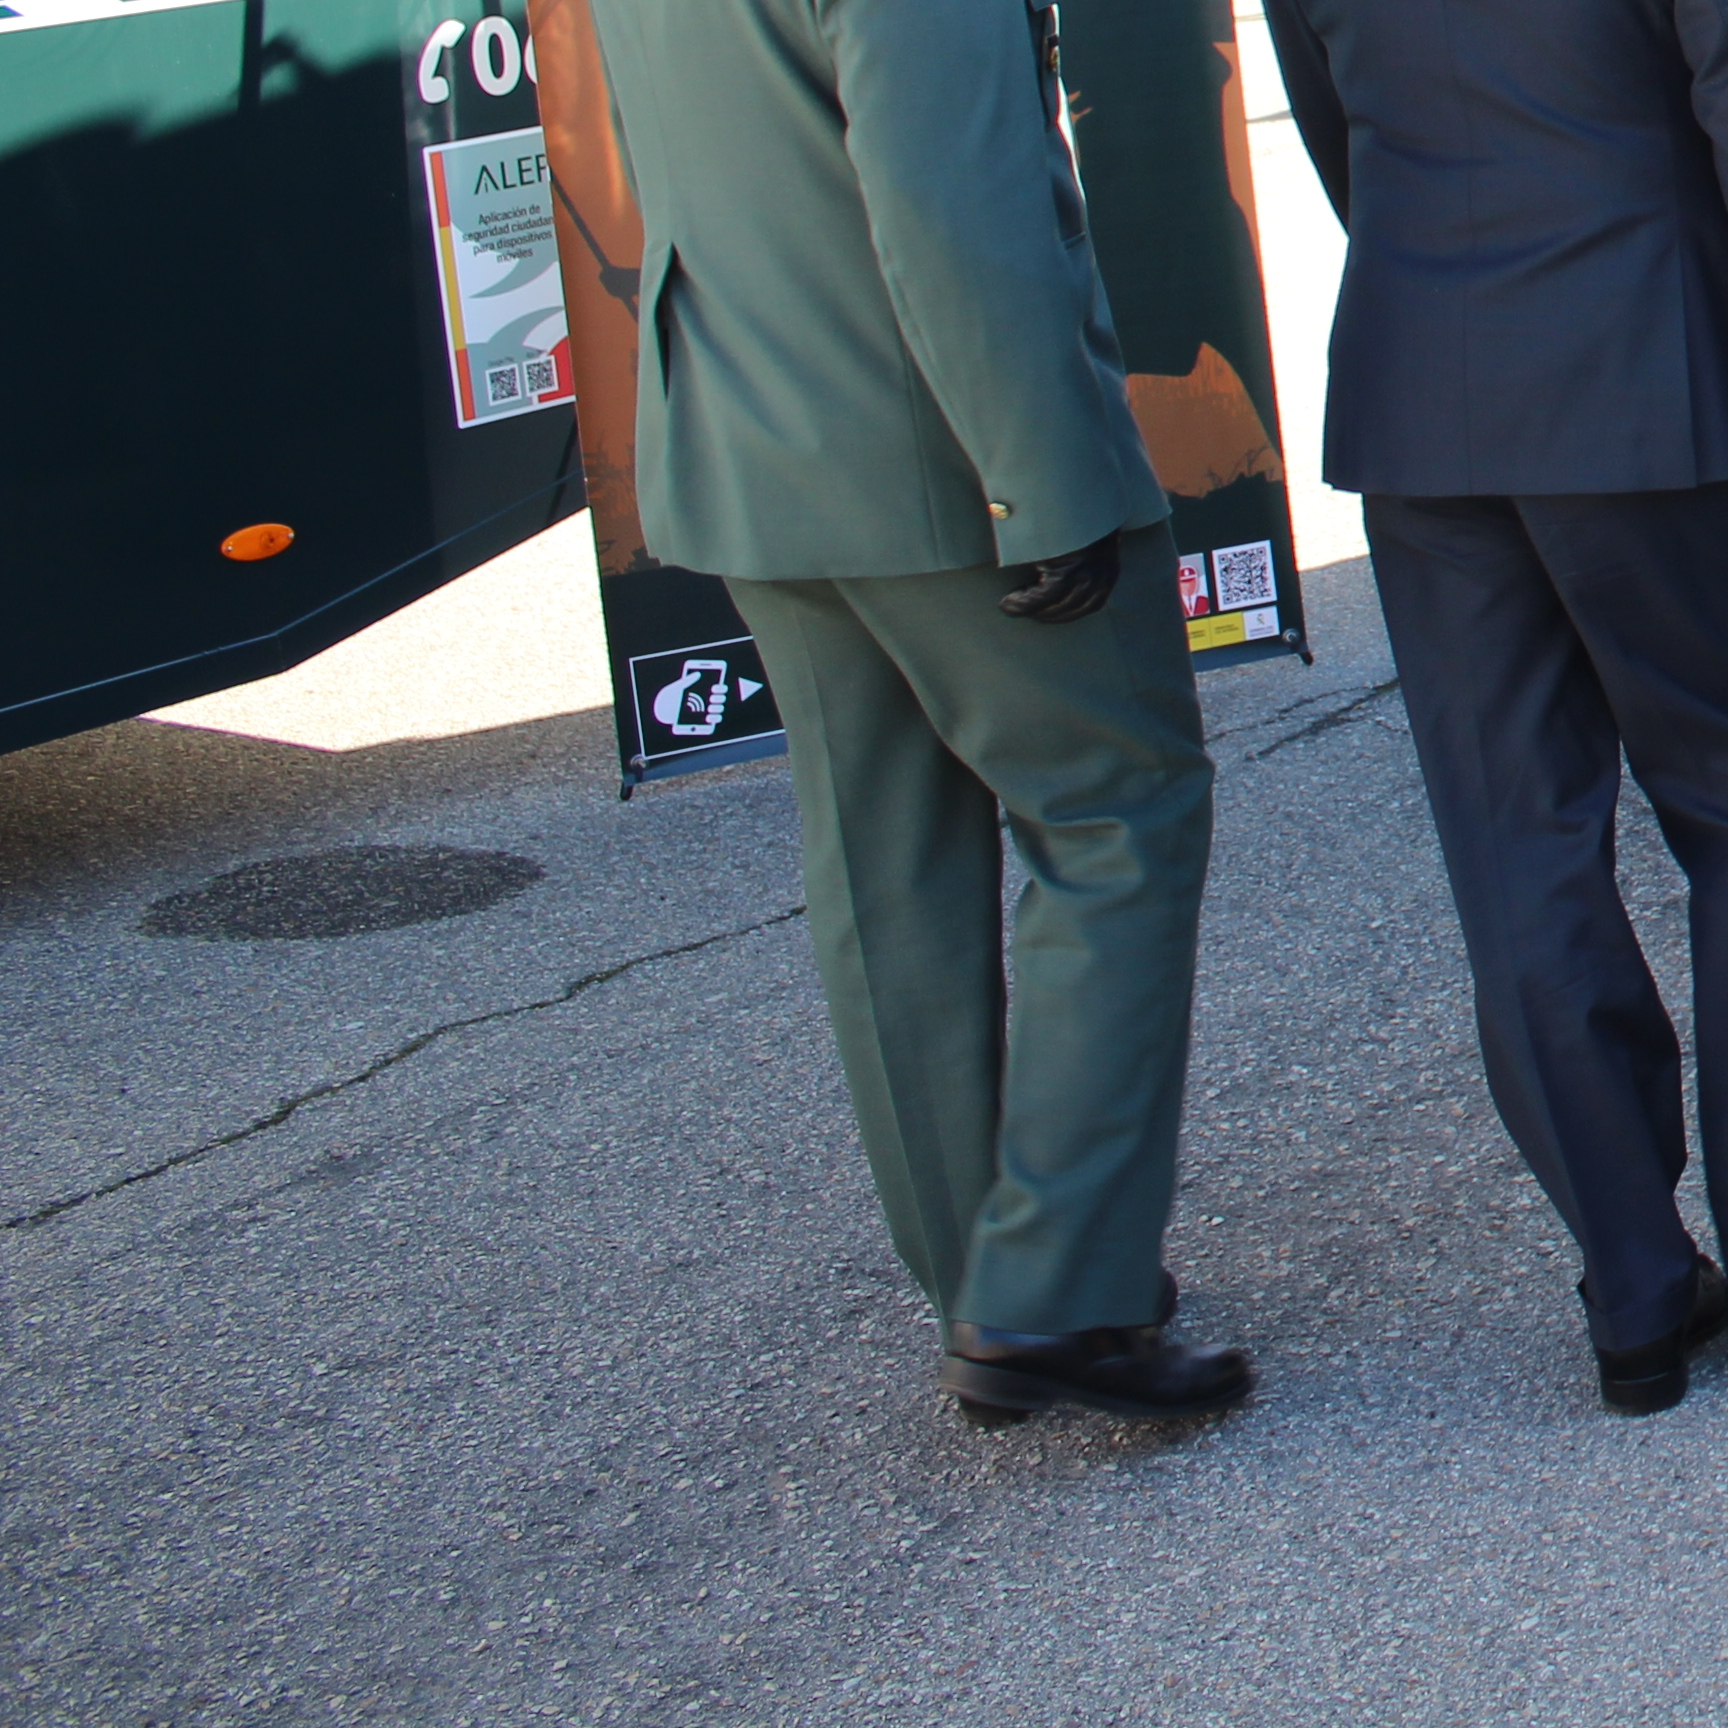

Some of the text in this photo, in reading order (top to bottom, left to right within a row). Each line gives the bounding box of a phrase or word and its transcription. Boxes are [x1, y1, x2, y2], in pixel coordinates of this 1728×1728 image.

[471, 15, 538, 96] 0
[478, 203, 541, 225] Aplicación de
[463, 223, 510, 243] seguridad
[473, 231, 552, 257] para dispositivos
